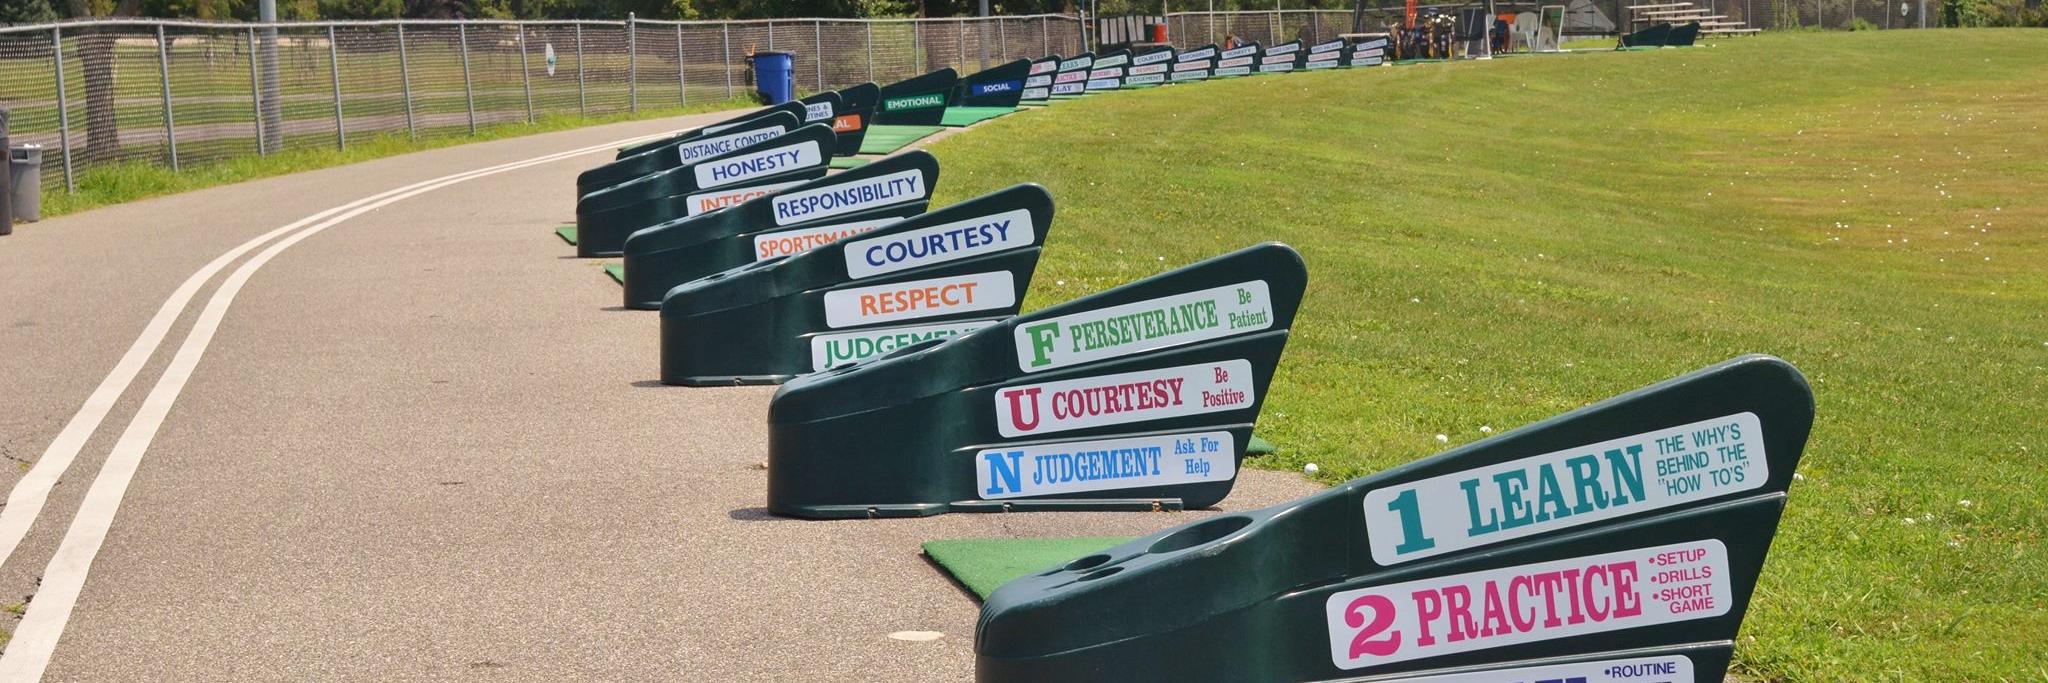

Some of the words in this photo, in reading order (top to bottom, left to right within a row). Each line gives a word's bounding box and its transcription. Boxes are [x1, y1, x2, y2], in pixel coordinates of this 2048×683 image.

[888, 96, 941, 110] EMOTIONAL
[983, 82, 1011, 93] SOCIAL
[834, 119, 851, 129] AL
[683, 140, 731, 160] DISTANCE
[712, 150, 800, 181] HONESTY
[777, 176, 917, 218] RESPONSIBILITY
[866, 220, 1011, 267] COURTESY
[860, 282, 978, 317] RESPECT
[1238, 287, 1252, 305] Be
[1025, 322, 1060, 367] F
[1069, 299, 1219, 353] PERSEVERANCE
[1229, 308, 1268, 330] Patient
[1214, 366, 1229, 383] Be
[1004, 387, 1042, 431] U
[1052, 377, 1184, 420] COURTESY
[1202, 390, 1245, 408] Positive
[1174, 438, 1194, 455] Ask
[1200, 437, 1219, 453] For
[1655, 434, 1685, 455] THE
[1692, 423, 1741, 447] WHY'S
[984, 451, 1024, 495] N
[1033, 446, 1162, 485] JUDGEMENT
[1185, 458, 1210, 477] Help
[1656, 452, 1709, 477] BEHIND
[1717, 443, 1747, 463] THE
[1658, 475, 1701, 497] "HOW
[1710, 462, 1750, 488] TO'S"
[1387, 488, 1435, 555] 1
[1460, 444, 1647, 538] LEARN
[1344, 593, 1401, 660] 2
[1412, 560, 1642, 647] PRACTICE
[1670, 597, 1714, 614] GAME
